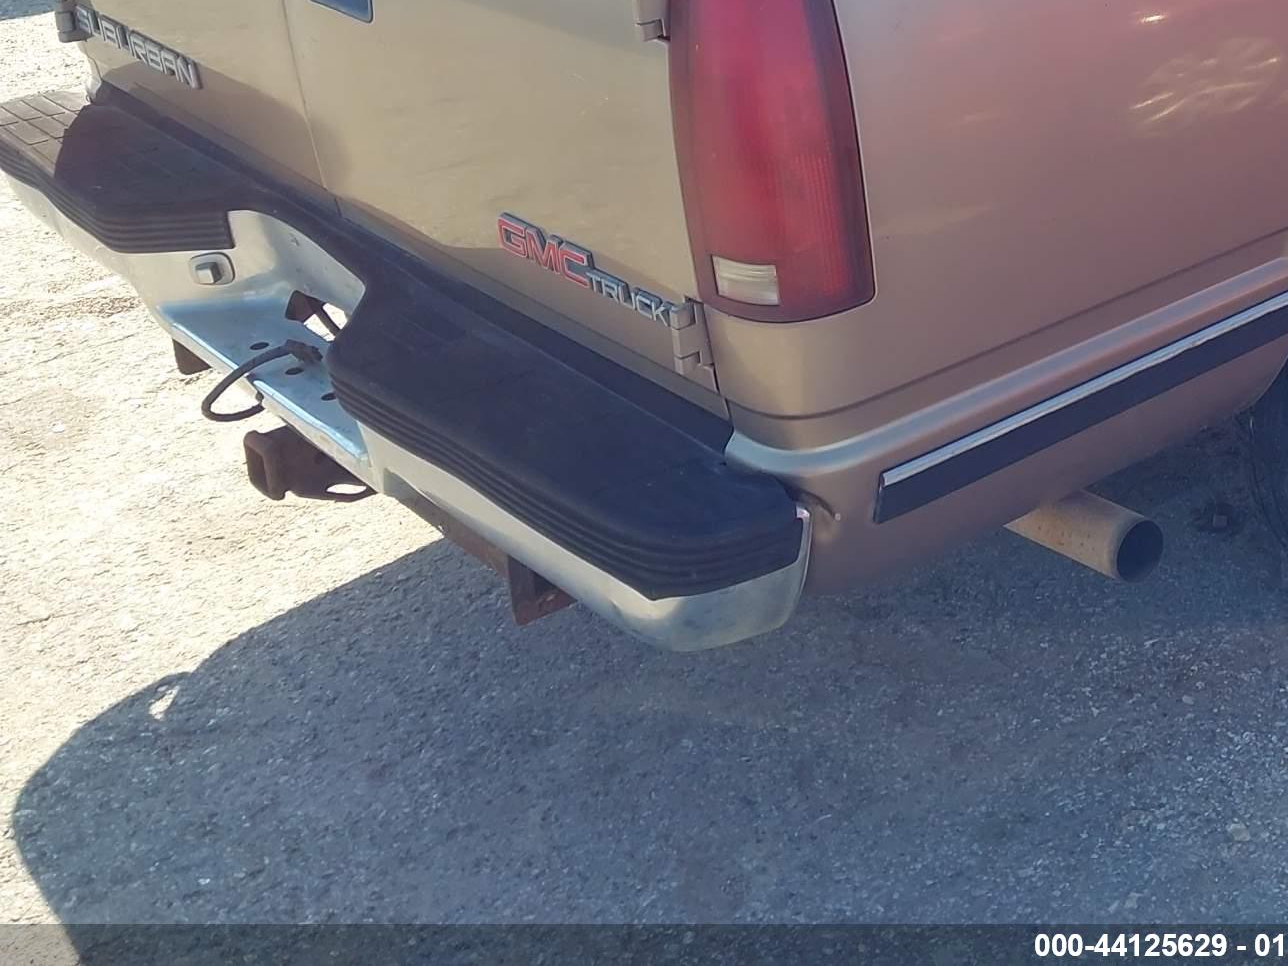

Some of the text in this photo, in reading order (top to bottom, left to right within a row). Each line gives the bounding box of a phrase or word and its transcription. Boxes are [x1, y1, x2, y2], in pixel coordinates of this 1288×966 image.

[75, 3, 202, 90] SUBURBAN
[498, 213, 680, 328] GMC TRUCK
